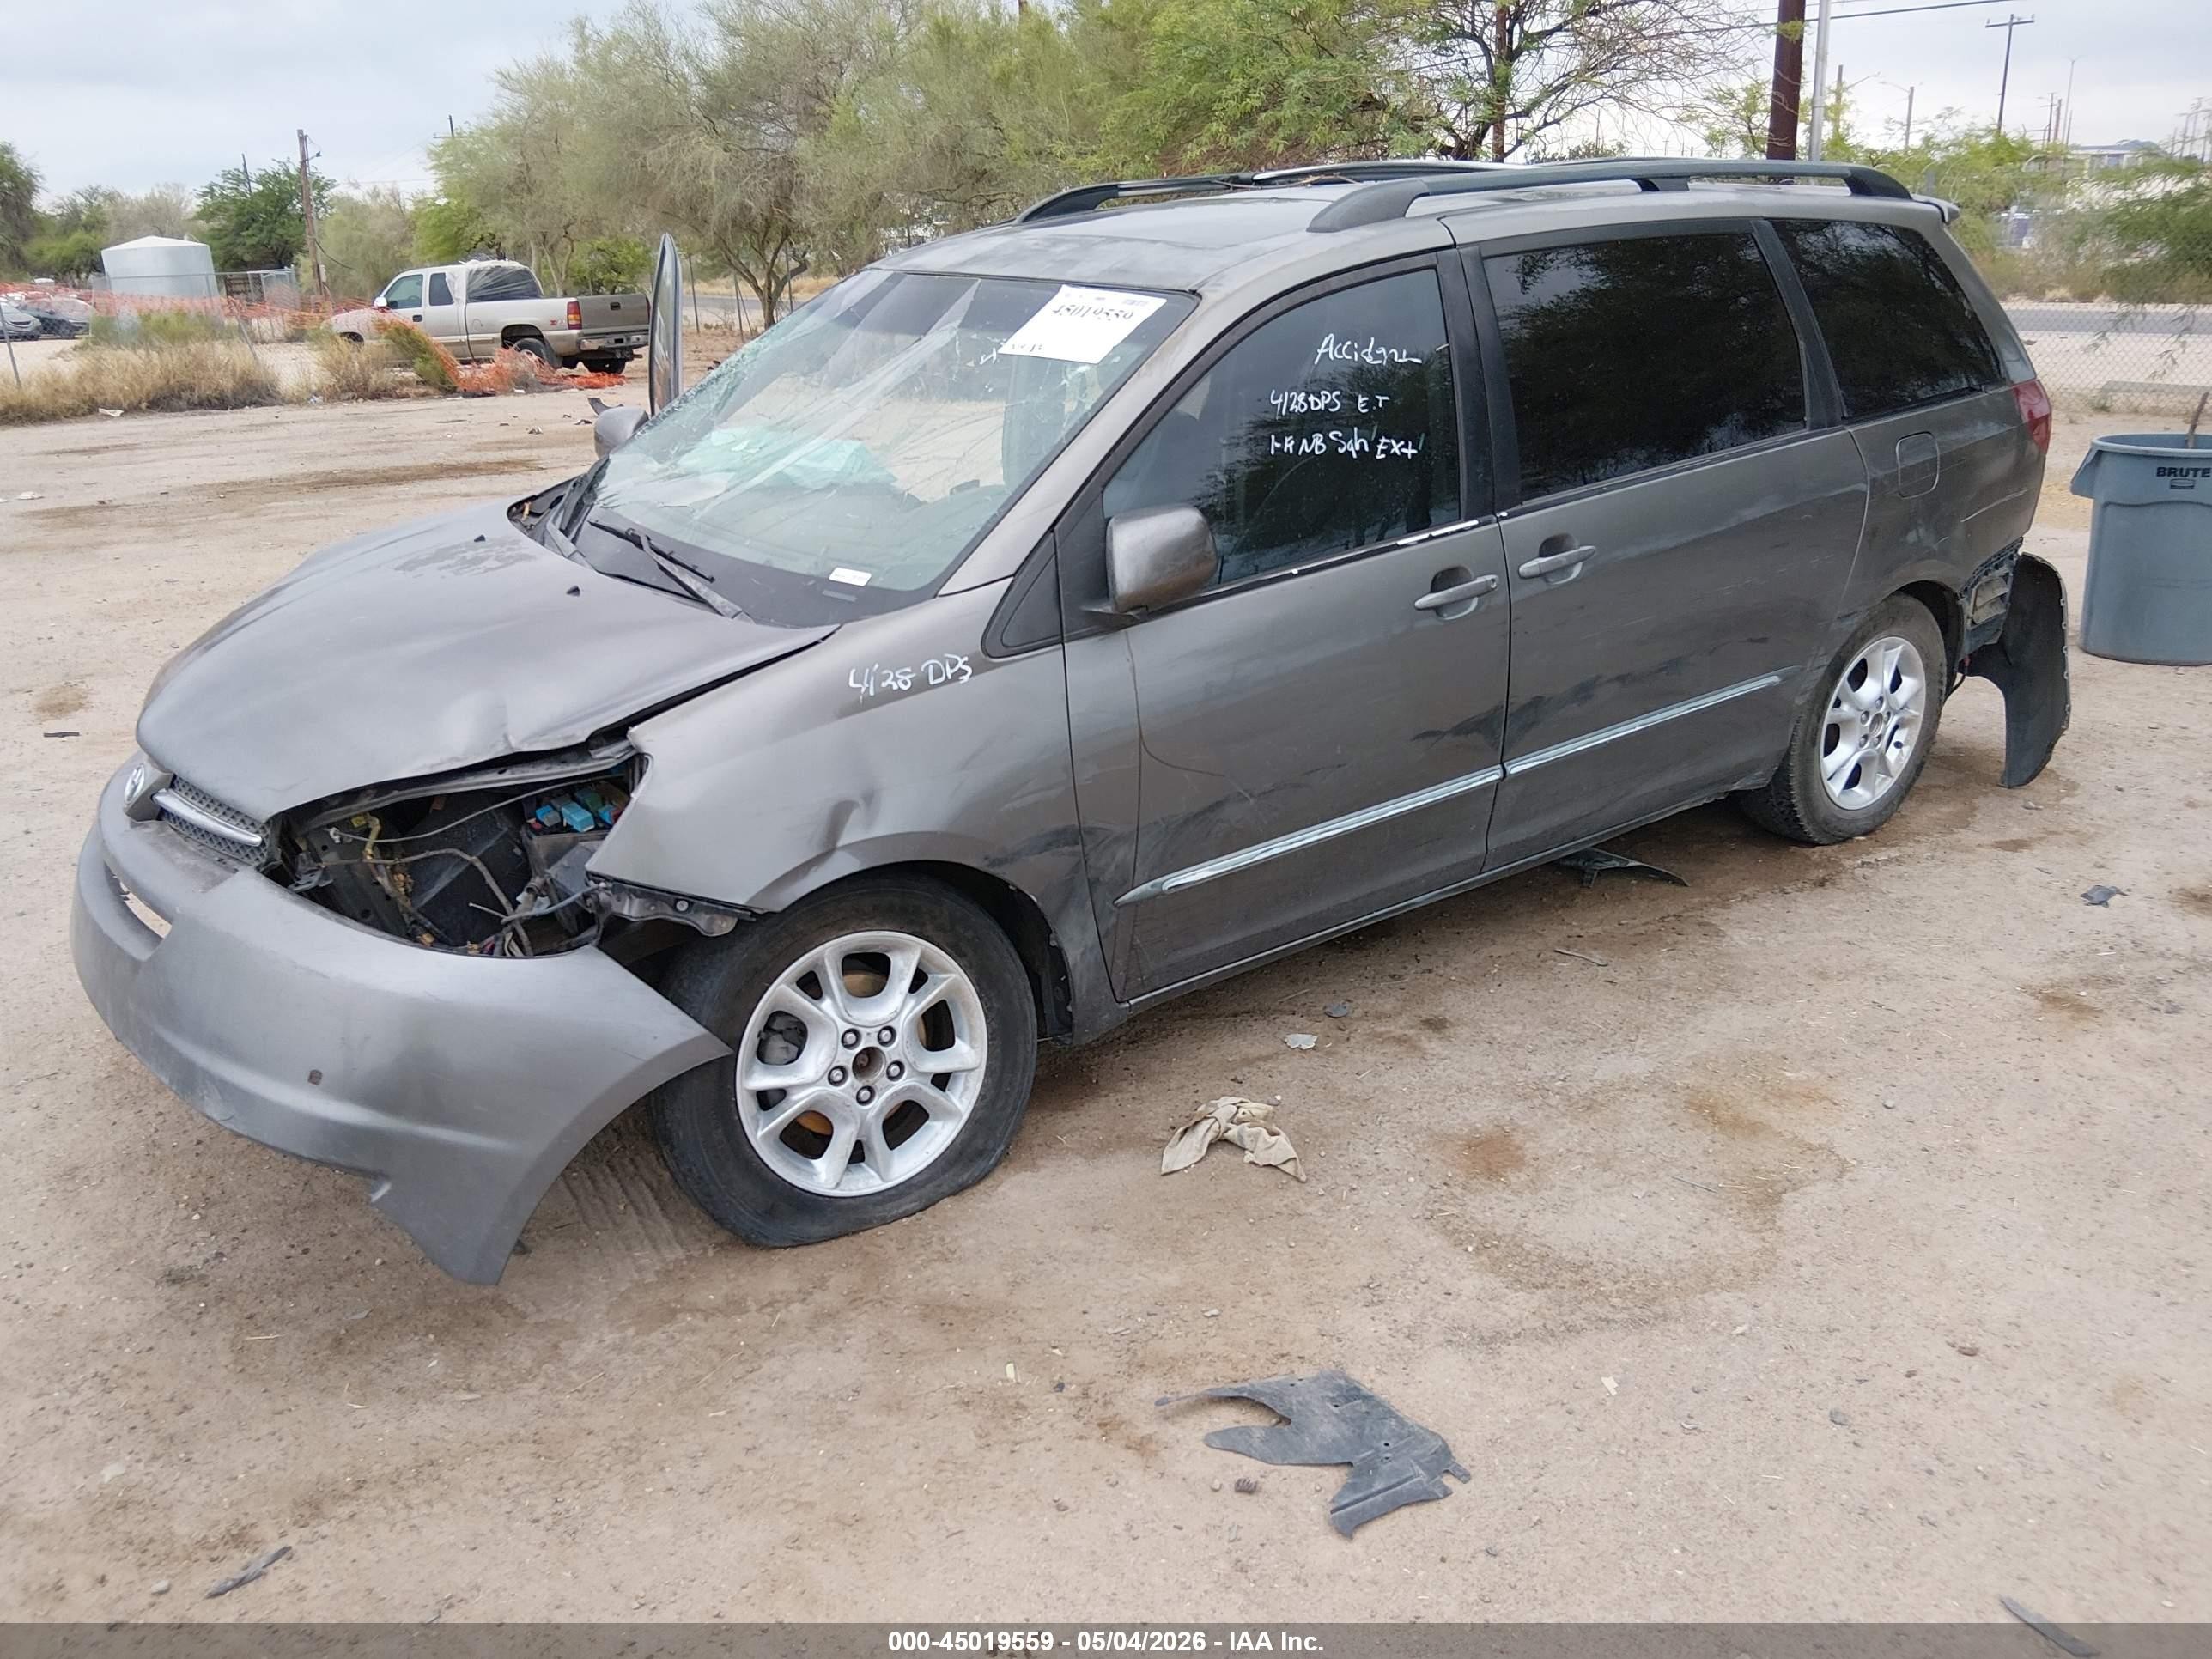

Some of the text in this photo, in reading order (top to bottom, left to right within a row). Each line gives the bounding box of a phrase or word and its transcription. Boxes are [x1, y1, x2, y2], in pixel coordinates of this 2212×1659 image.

[1298, 433, 1327, 456] NB
[2156, 466, 2211, 478] BRUTE
[921, 653, 973, 684] DPS
